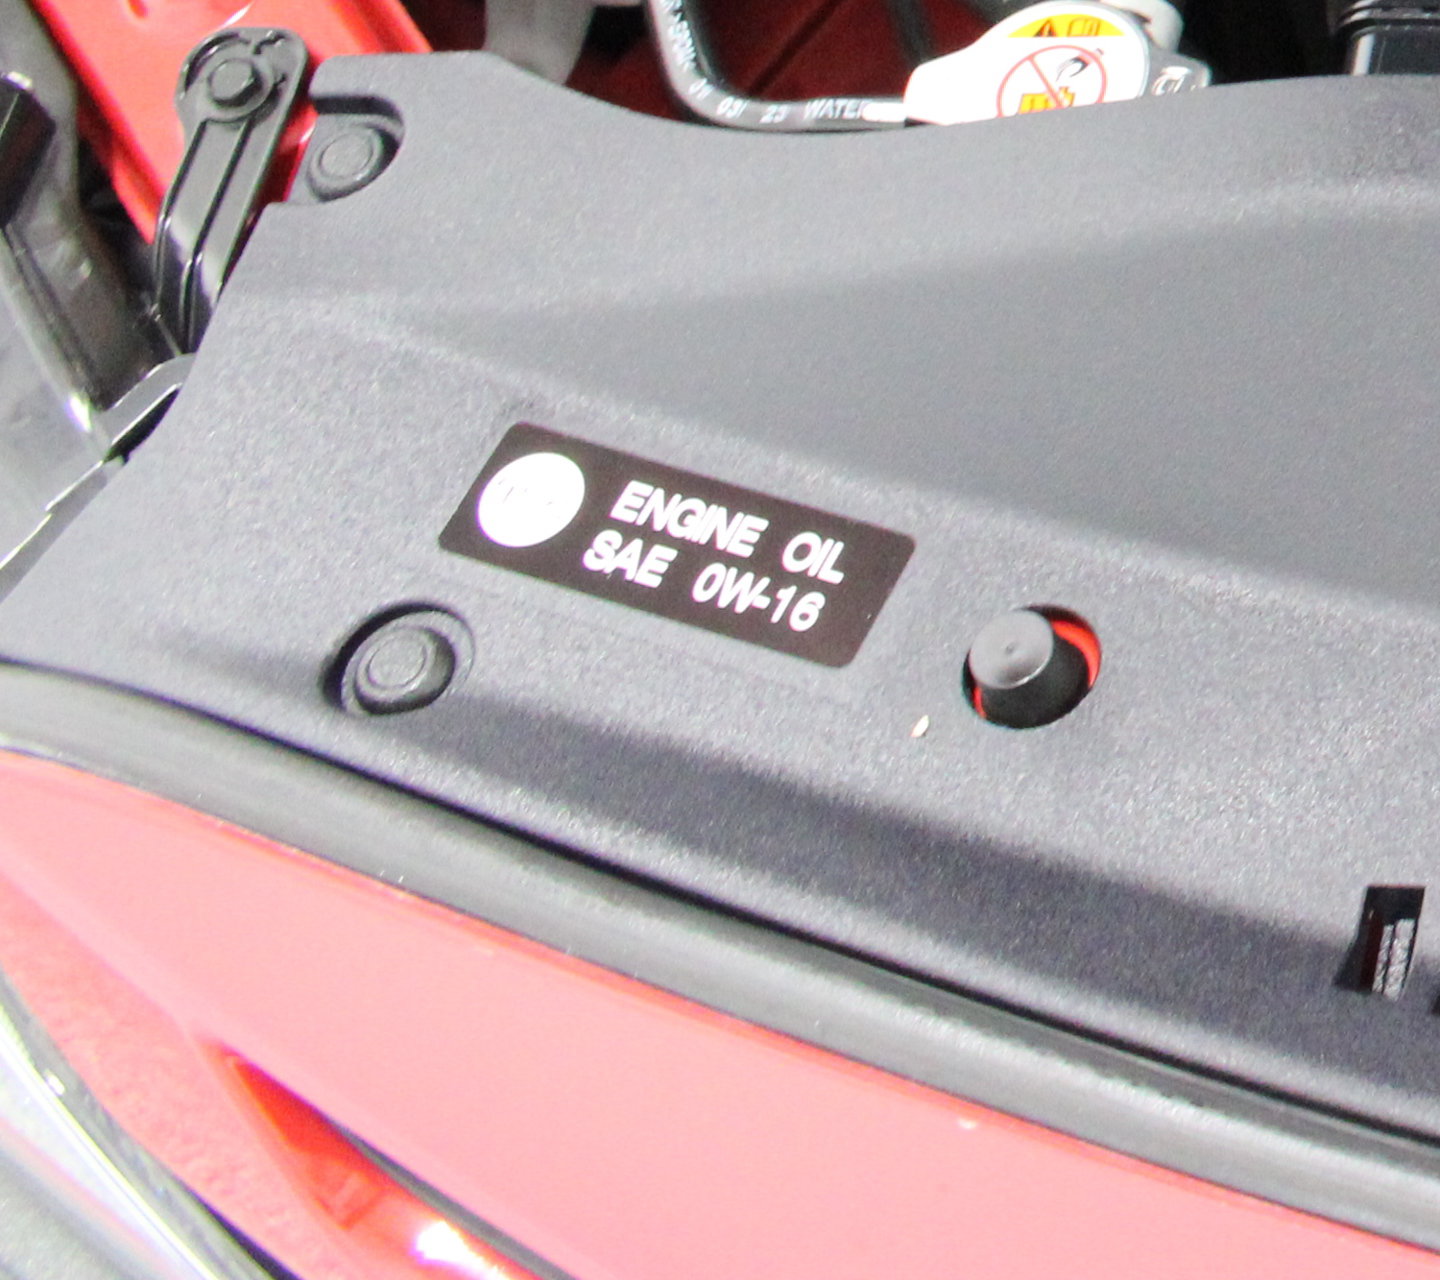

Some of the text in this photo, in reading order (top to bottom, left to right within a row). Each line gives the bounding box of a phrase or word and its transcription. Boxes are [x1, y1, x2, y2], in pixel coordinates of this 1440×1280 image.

[581, 529, 827, 633] SAE 0W-16
[609, 480, 770, 559] ENGINE
[780, 531, 845, 585] OIL
